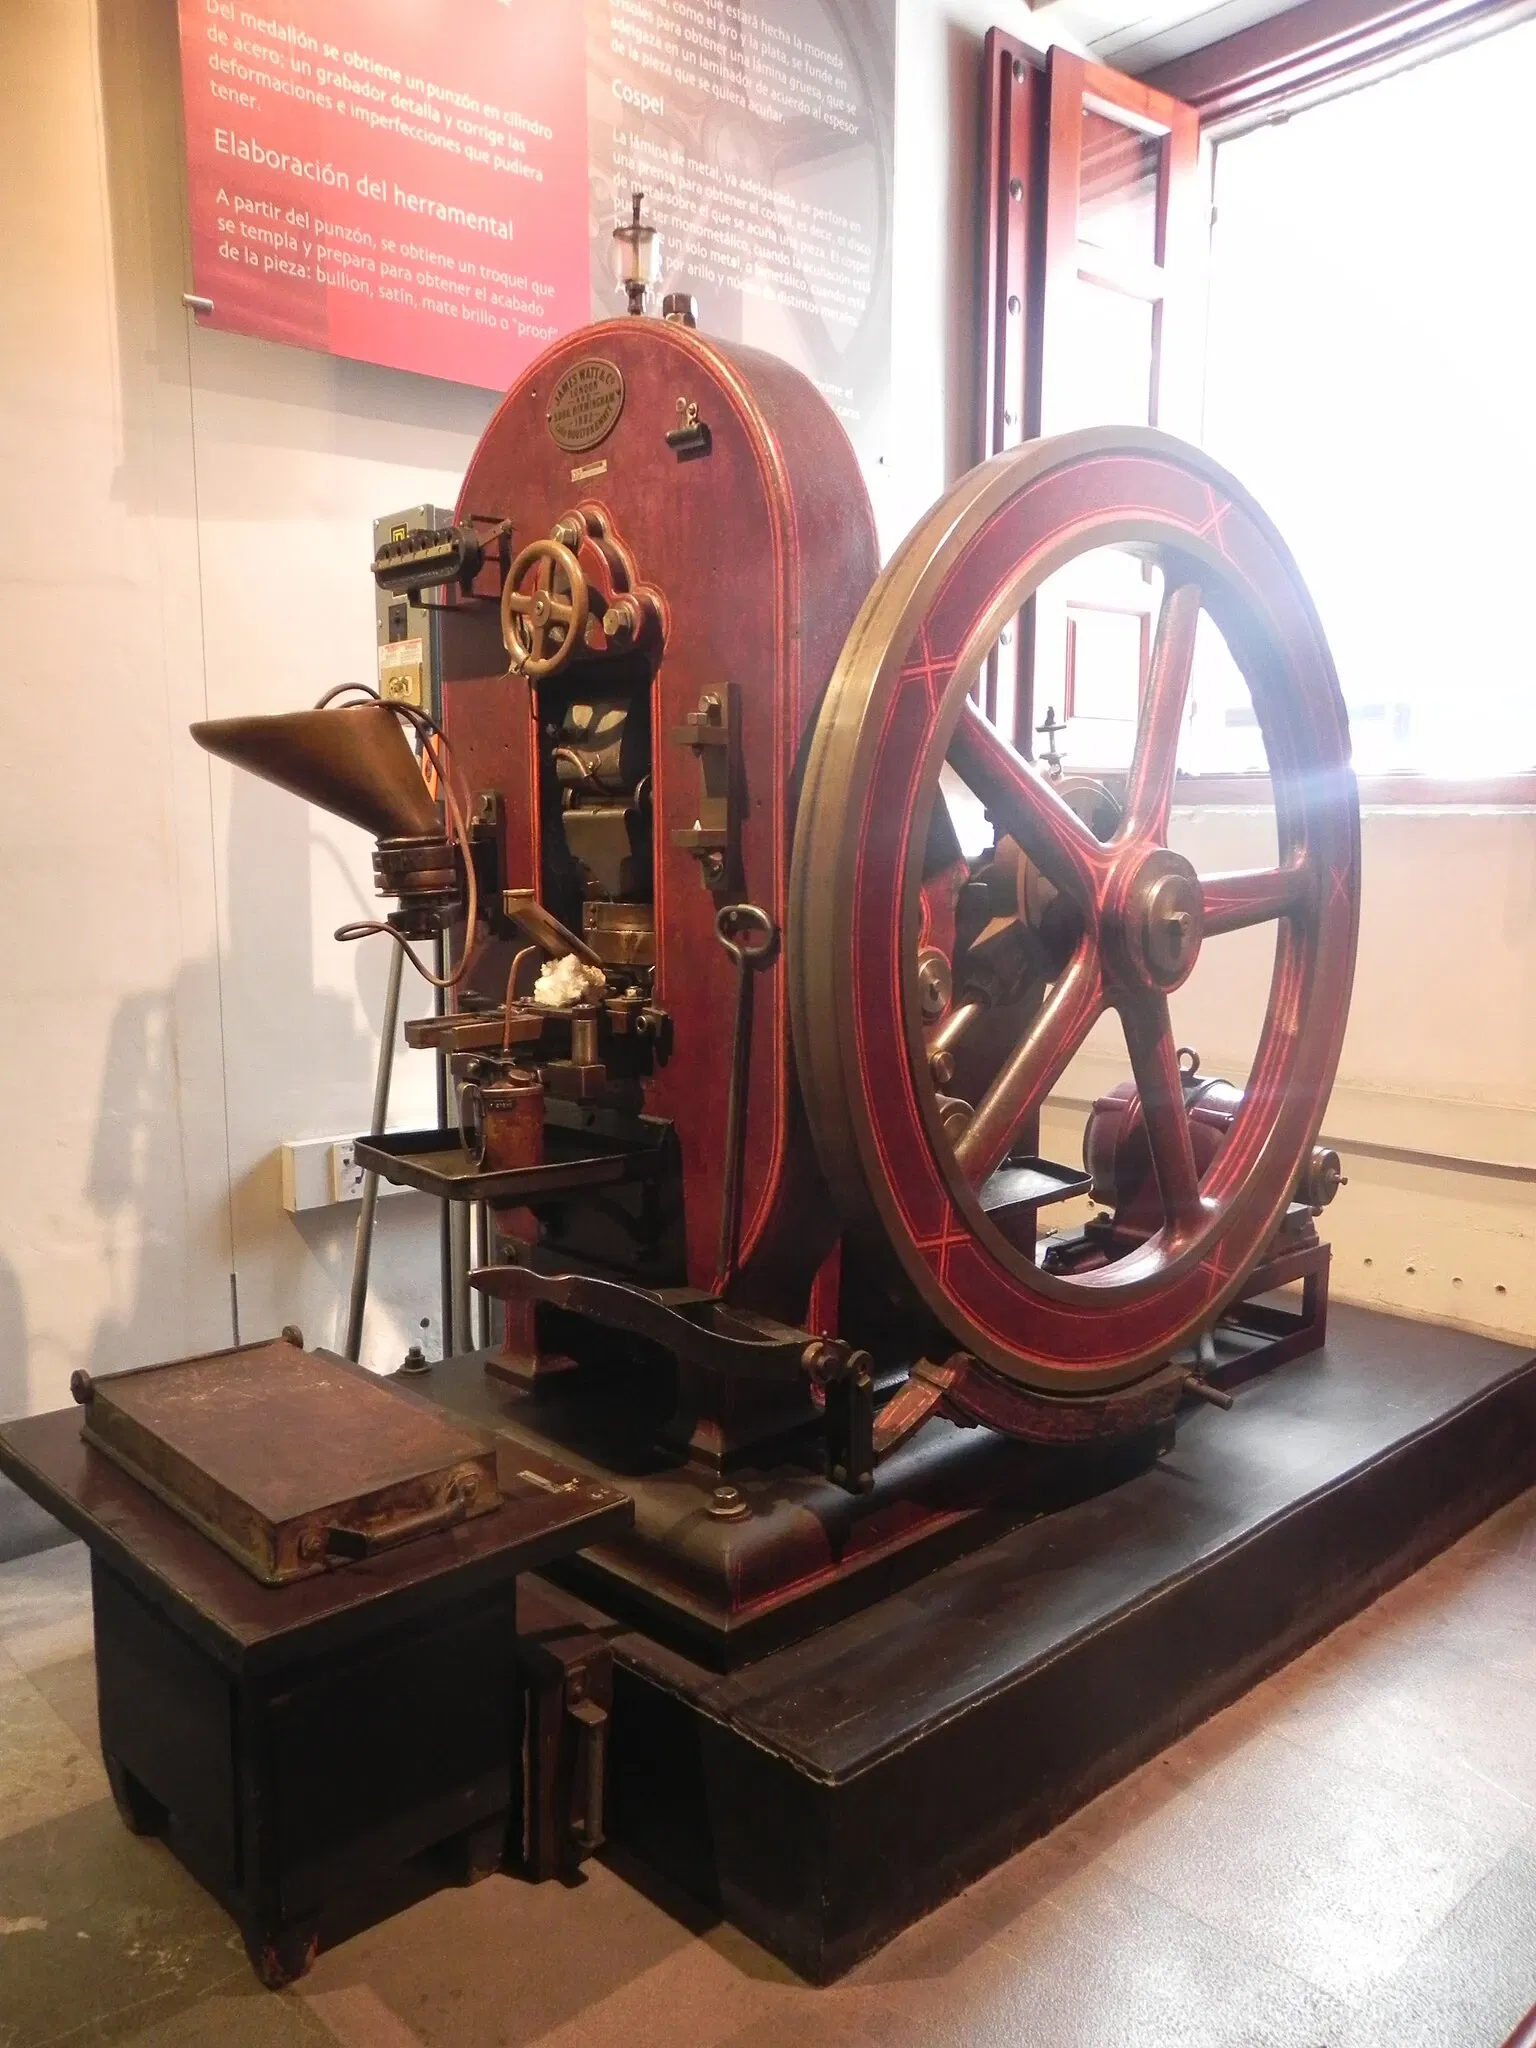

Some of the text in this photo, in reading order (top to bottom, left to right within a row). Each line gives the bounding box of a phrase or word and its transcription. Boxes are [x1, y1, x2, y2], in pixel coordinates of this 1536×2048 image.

[206, 0, 553, 140] Del medallón se obtiene un punzón en cilindro
[610, 38, 625, 56] de
[628, 44, 639, 62] la
[642, 52, 672, 76] pieza
[674, 67, 696, 87] que
[698, 77, 711, 93] se
[712, 84, 746, 108] quiera
[656, 14, 681, 37] para
[684, 28, 727, 56] obtener
[730, 49, 750, 68] una
[752, 55, 787, 84] lámina
[826, 93, 845, 109] que
[846, 102, 857, 116] se
[672, 1, 704, 25] como
[707, 16, 717, 31] el
[719, 23, 738, 40] oro
[740, 34, 747, 47] y
[749, 33, 758, 50] la
[792, 57, 802, 70] se
[805, 60, 833, 85] funde
[835, 76, 847, 92] en
[726, 5, 758, 30] estará
[761, 18, 790, 45] hecha
[793, 34, 802, 50] la
[804, 42, 844, 70] moneda
[207, 24, 229, 46] de
[290, 57, 312, 77] un
[316, 67, 387, 103] grabador
[391, 92, 440, 123] detalla
[444, 113, 453, 130] y
[456, 118, 505, 147] corrige
[508, 133, 526, 153] las
[208, 52, 544, 183] deformaciones e imperfecciones que pudiera
[210, 80, 262, 111] tener.
[611, 78, 664, 116] Cospel
[664, 41, 678, 56] en
[681, 47, 696, 65] un
[699, 53, 752, 88] laminador
[755, 80, 768, 96] de
[771, 87, 810, 115] acuerdo
[812, 105, 821, 120] al
[823, 111, 859, 135] espesor
[214, 128, 514, 241] Elaboración del herramental
[612, 152, 635, 171] una
[638, 159, 675, 185] prensa
[679, 175, 703, 195] para
[705, 185, 747, 210] obtener
[749, 200, 759, 215] el
[613, 127, 626, 145] La
[629, 132, 668, 164] lámina
[671, 150, 685, 168] de
[724, 171, 737, 188] ya
[800, 202, 811, 214] se
[813, 206, 847, 228] perfora
[849, 221, 861, 233] en
[613, 171, 628, 189] de
[666, 192, 696, 213] sobre
[699, 203, 709, 219] el
[711, 210, 731, 226] que
[734, 217, 744, 231] se
[747, 222, 777, 243] acuña
[780, 234, 798, 250] una
[216, 188, 555, 298] A partir del punzón, se obtiene un troquel que
[217, 217, 544, 317] se templa y prepara para obtener el acabado
[653, 209, 668, 224] ser
[753, 244, 790, 266] cuando
[793, 255, 802, 270] la
[666, 257, 684, 273] por
[687, 262, 715, 282] arillo
[717, 274, 725, 287] y
[668, 236, 682, 250] un
[685, 240, 707, 258] solo
[218, 240, 239, 261] de
[245, 246, 259, 266] la
[264, 254, 312, 279] pieza:
[422, 296, 458, 317] mate
[462, 304, 496, 328] brillo
[500, 317, 509, 330] o
[554, 374, 578, 407] JAMES
[579, 367, 600, 381] WATT
